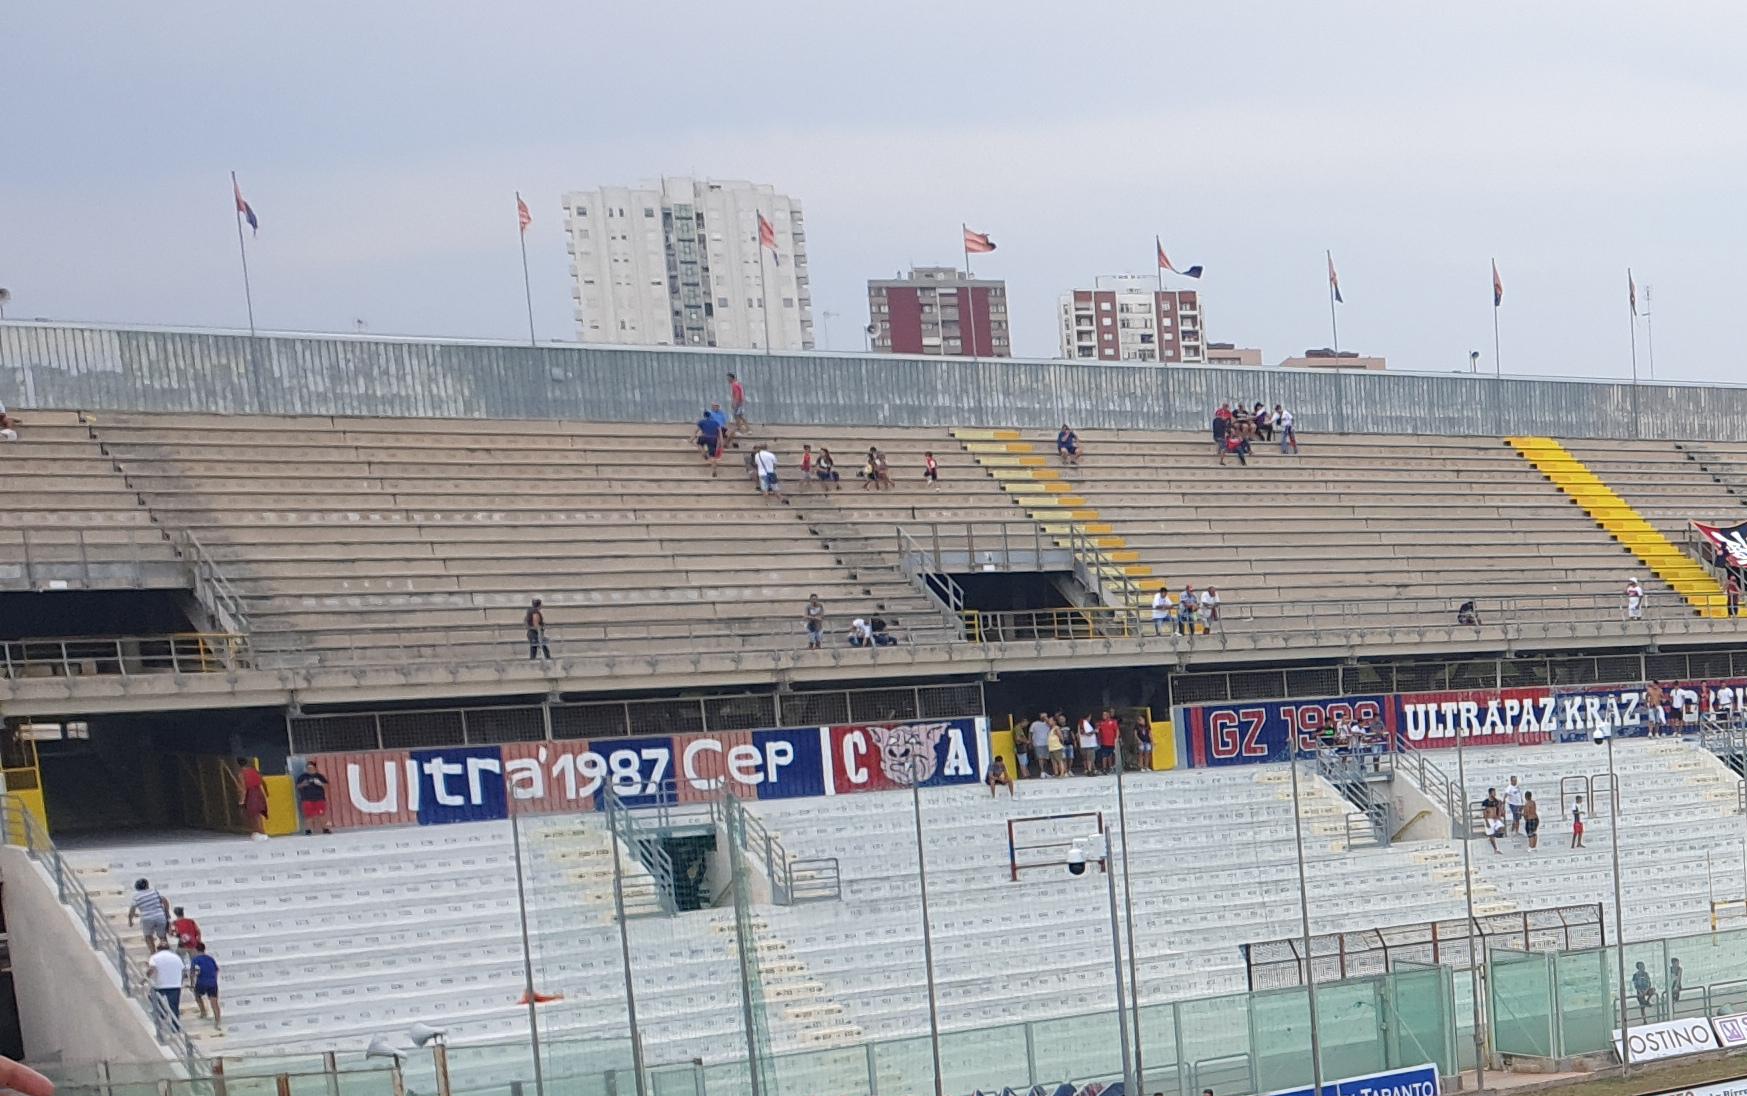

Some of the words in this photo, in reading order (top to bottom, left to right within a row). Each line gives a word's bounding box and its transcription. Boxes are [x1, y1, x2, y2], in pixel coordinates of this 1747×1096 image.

[1209, 708, 1268, 758] GZ
[1404, 697, 1557, 741] ULTRAPAZ
[1564, 692, 1648, 731] KRAZ
[843, 741, 866, 800] C
[944, 728, 971, 776] A
